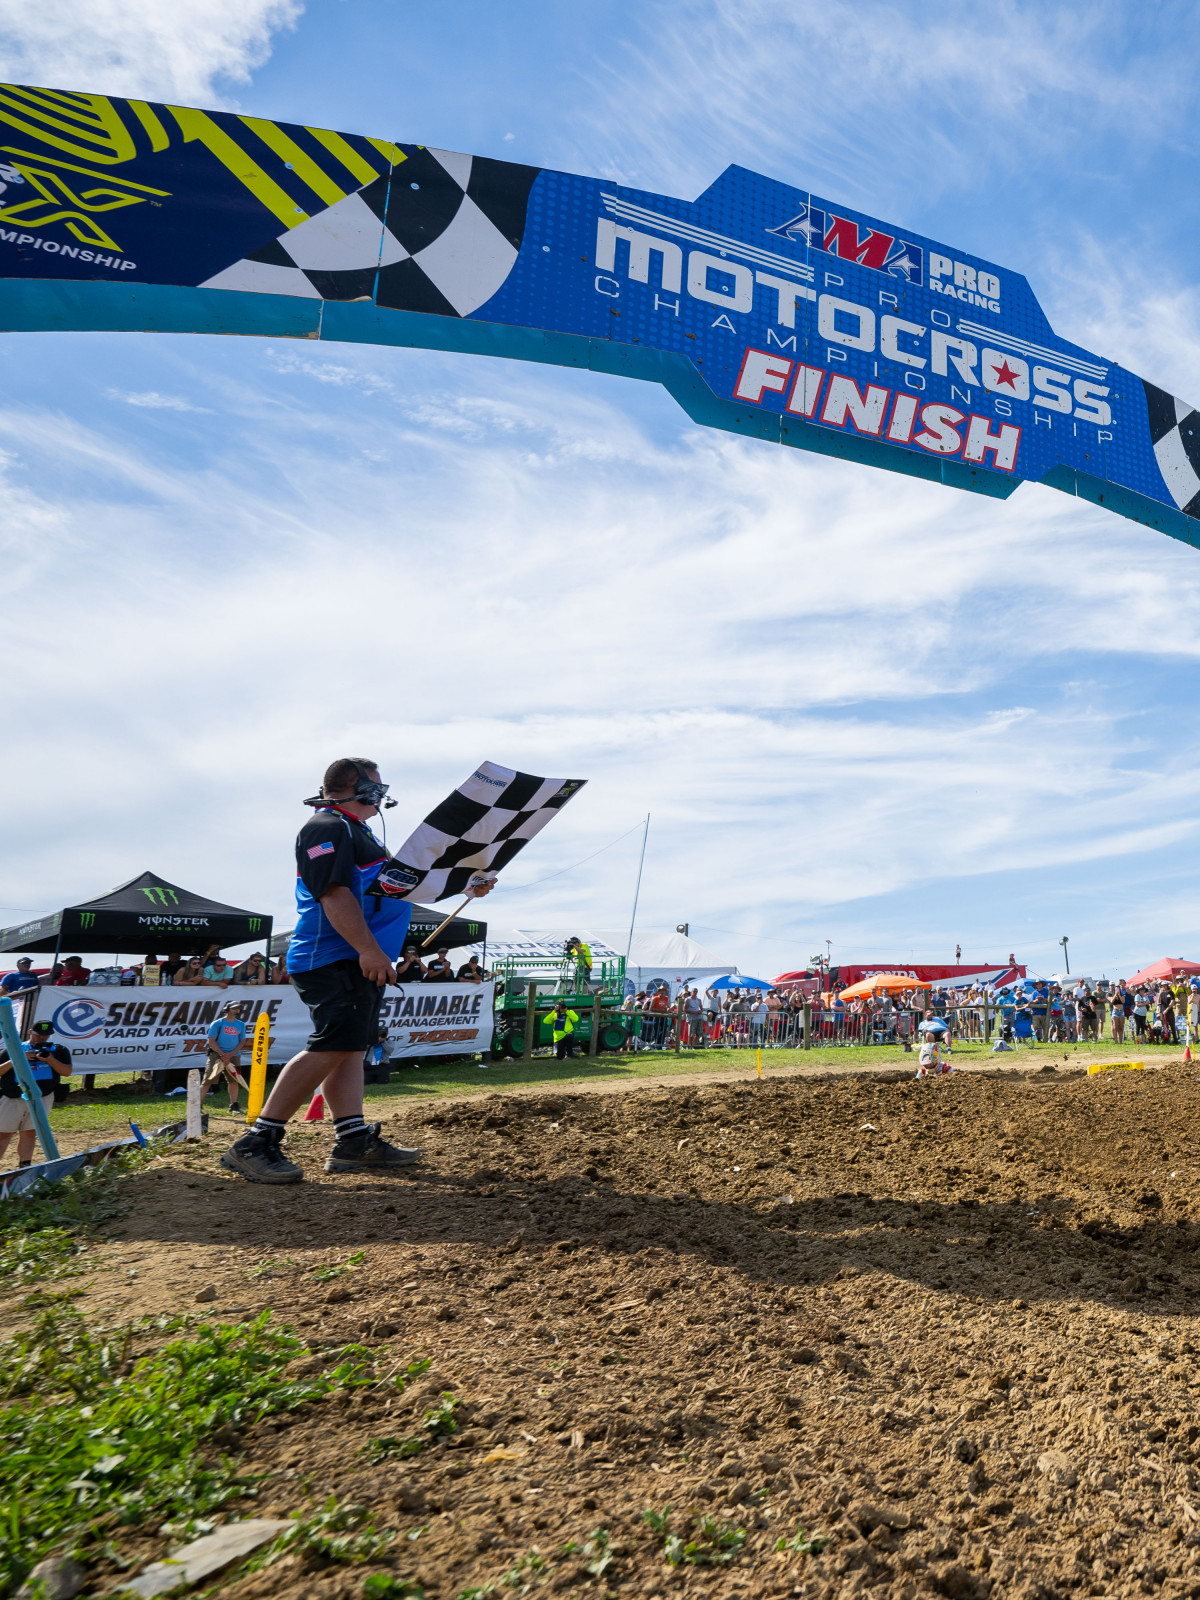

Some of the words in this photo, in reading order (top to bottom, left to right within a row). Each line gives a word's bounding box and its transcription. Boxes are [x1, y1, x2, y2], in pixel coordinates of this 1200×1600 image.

[765, 201, 924, 287] AMA
[929, 251, 1001, 300] PRO
[824, 271, 951, 328] PRO
[929, 277, 1001, 314] RACING
[595, 217, 1112, 426] MOTOCROSS
[594, 275, 1114, 445] CHAMPIONSHIP
[732, 347, 1022, 473] FINISH
[138, 916, 210, 927] MONSTER
[104, 1028, 151, 1039] YARD
[389, 1016, 479, 1028] MANAGEMENT
[408, 1029, 480, 1043] TUCKER
[72, 1045, 150, 1056] DIVISION
[154, 1043, 176, 1051] OF
[255, 1026, 266, 1065] ACERBIS
